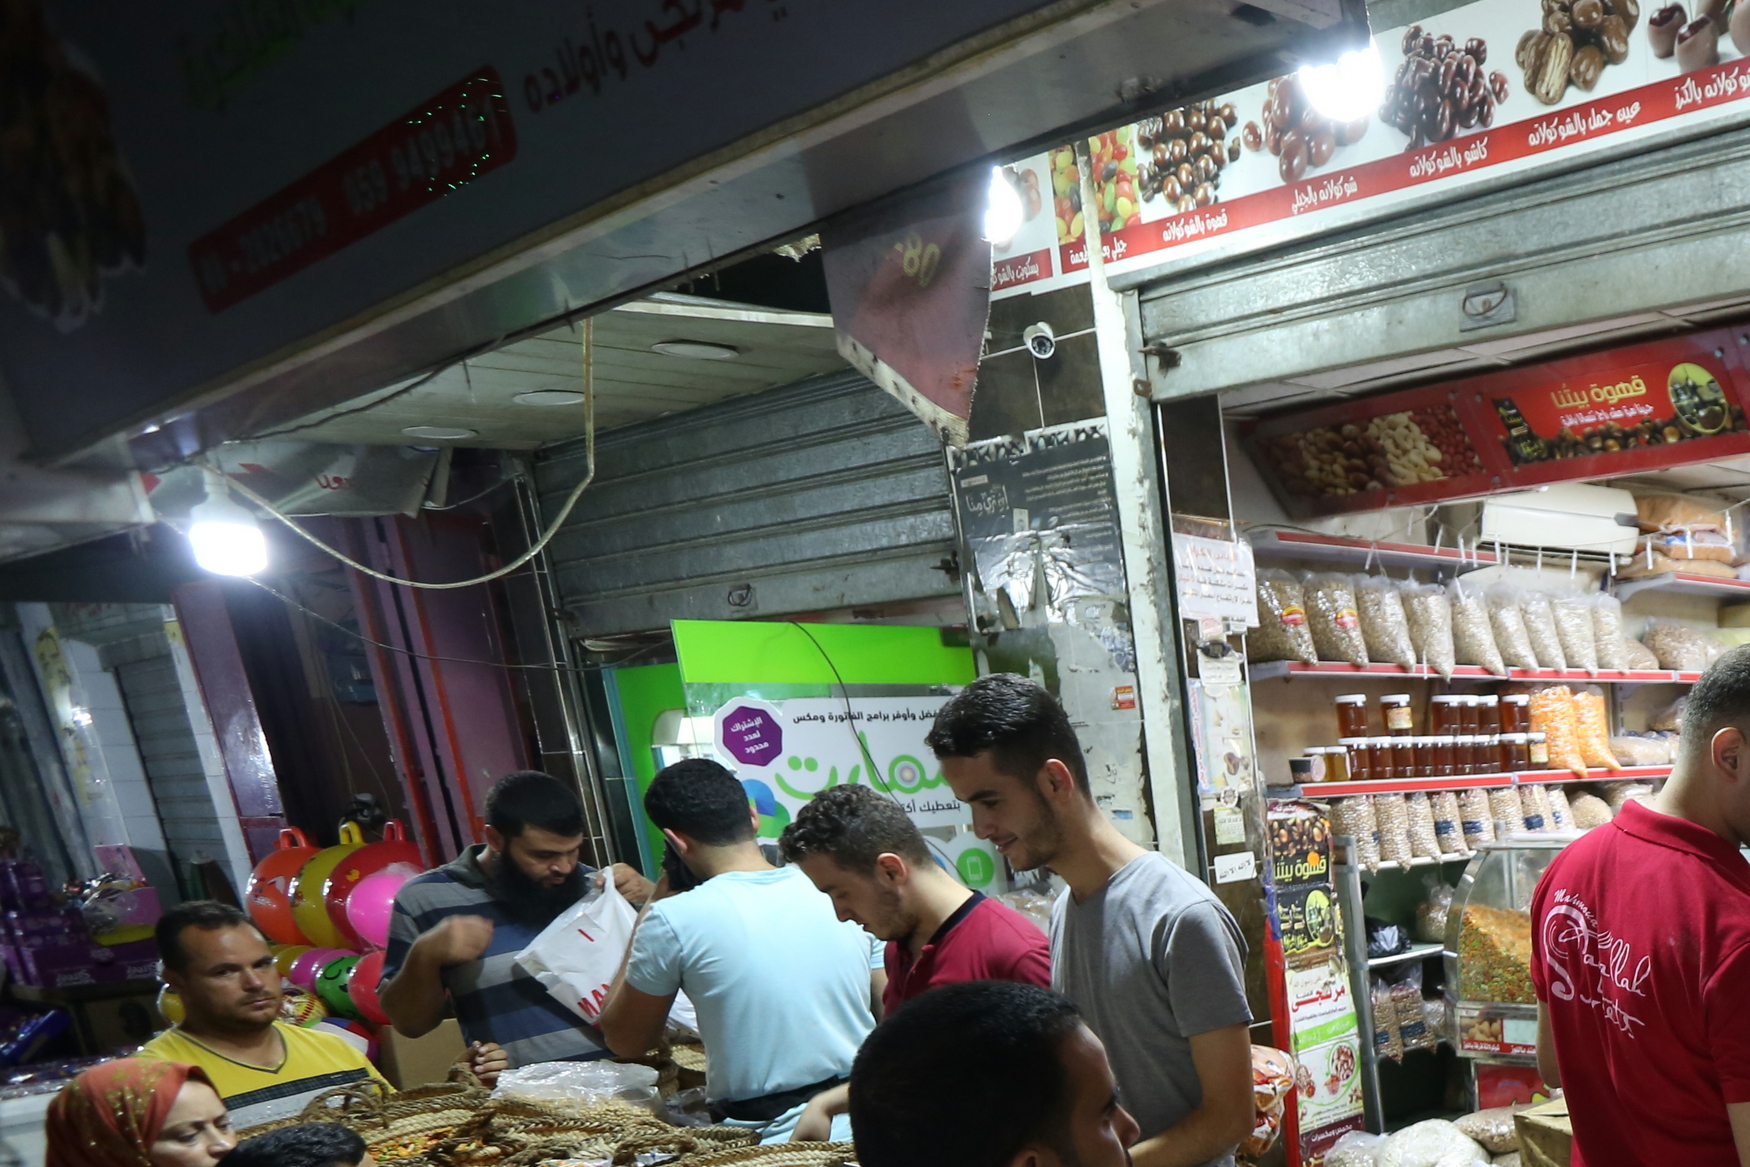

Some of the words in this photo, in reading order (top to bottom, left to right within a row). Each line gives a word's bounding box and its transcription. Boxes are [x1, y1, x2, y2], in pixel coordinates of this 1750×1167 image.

[1674, 81, 1703, 110] بالكرز
[1464, 137, 1488, 165] كاشو
[1206, 207, 1229, 231] قهوة
[1589, 374, 1647, 404] قهوة
[792, 712, 827, 724] ومكس
[865, 710, 891, 723] برامج
[743, 730, 761, 742] لعدد
[744, 740, 769, 754] محدود
[774, 730, 953, 802] مارت
[919, 799, 961, 814] بتعطيك
